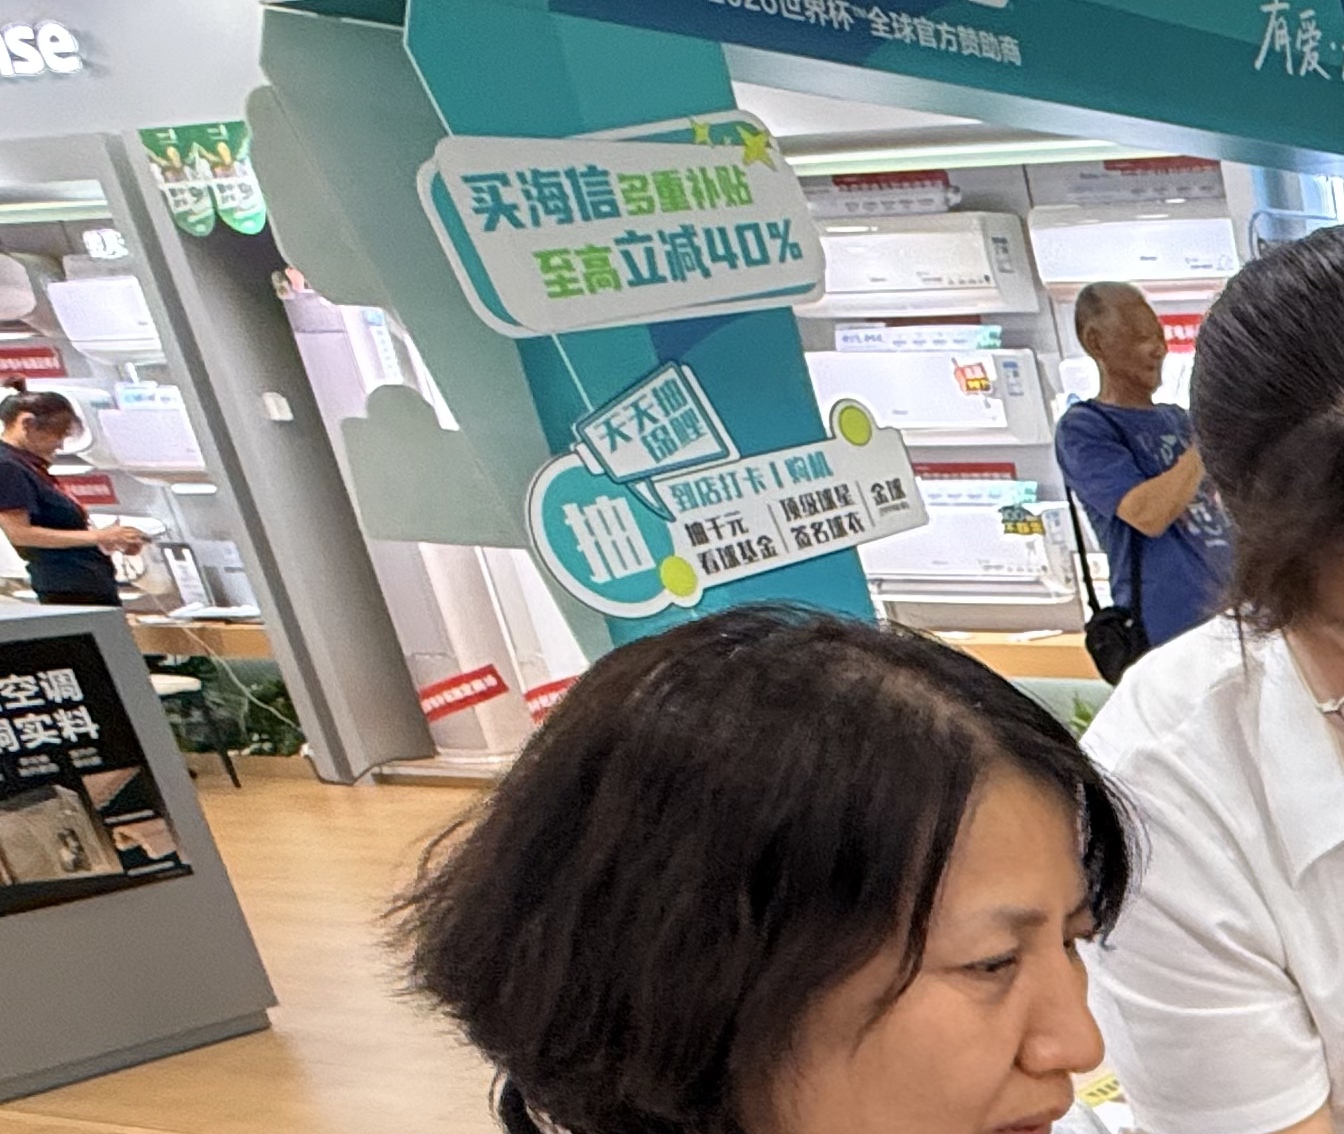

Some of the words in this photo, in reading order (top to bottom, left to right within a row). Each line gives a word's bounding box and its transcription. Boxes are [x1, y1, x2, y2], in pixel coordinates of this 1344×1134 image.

[460, 164, 754, 232] 买海信多重补贴
[533, 219, 803, 299] 至高立减40%
[563, 496, 656, 583] 抽
